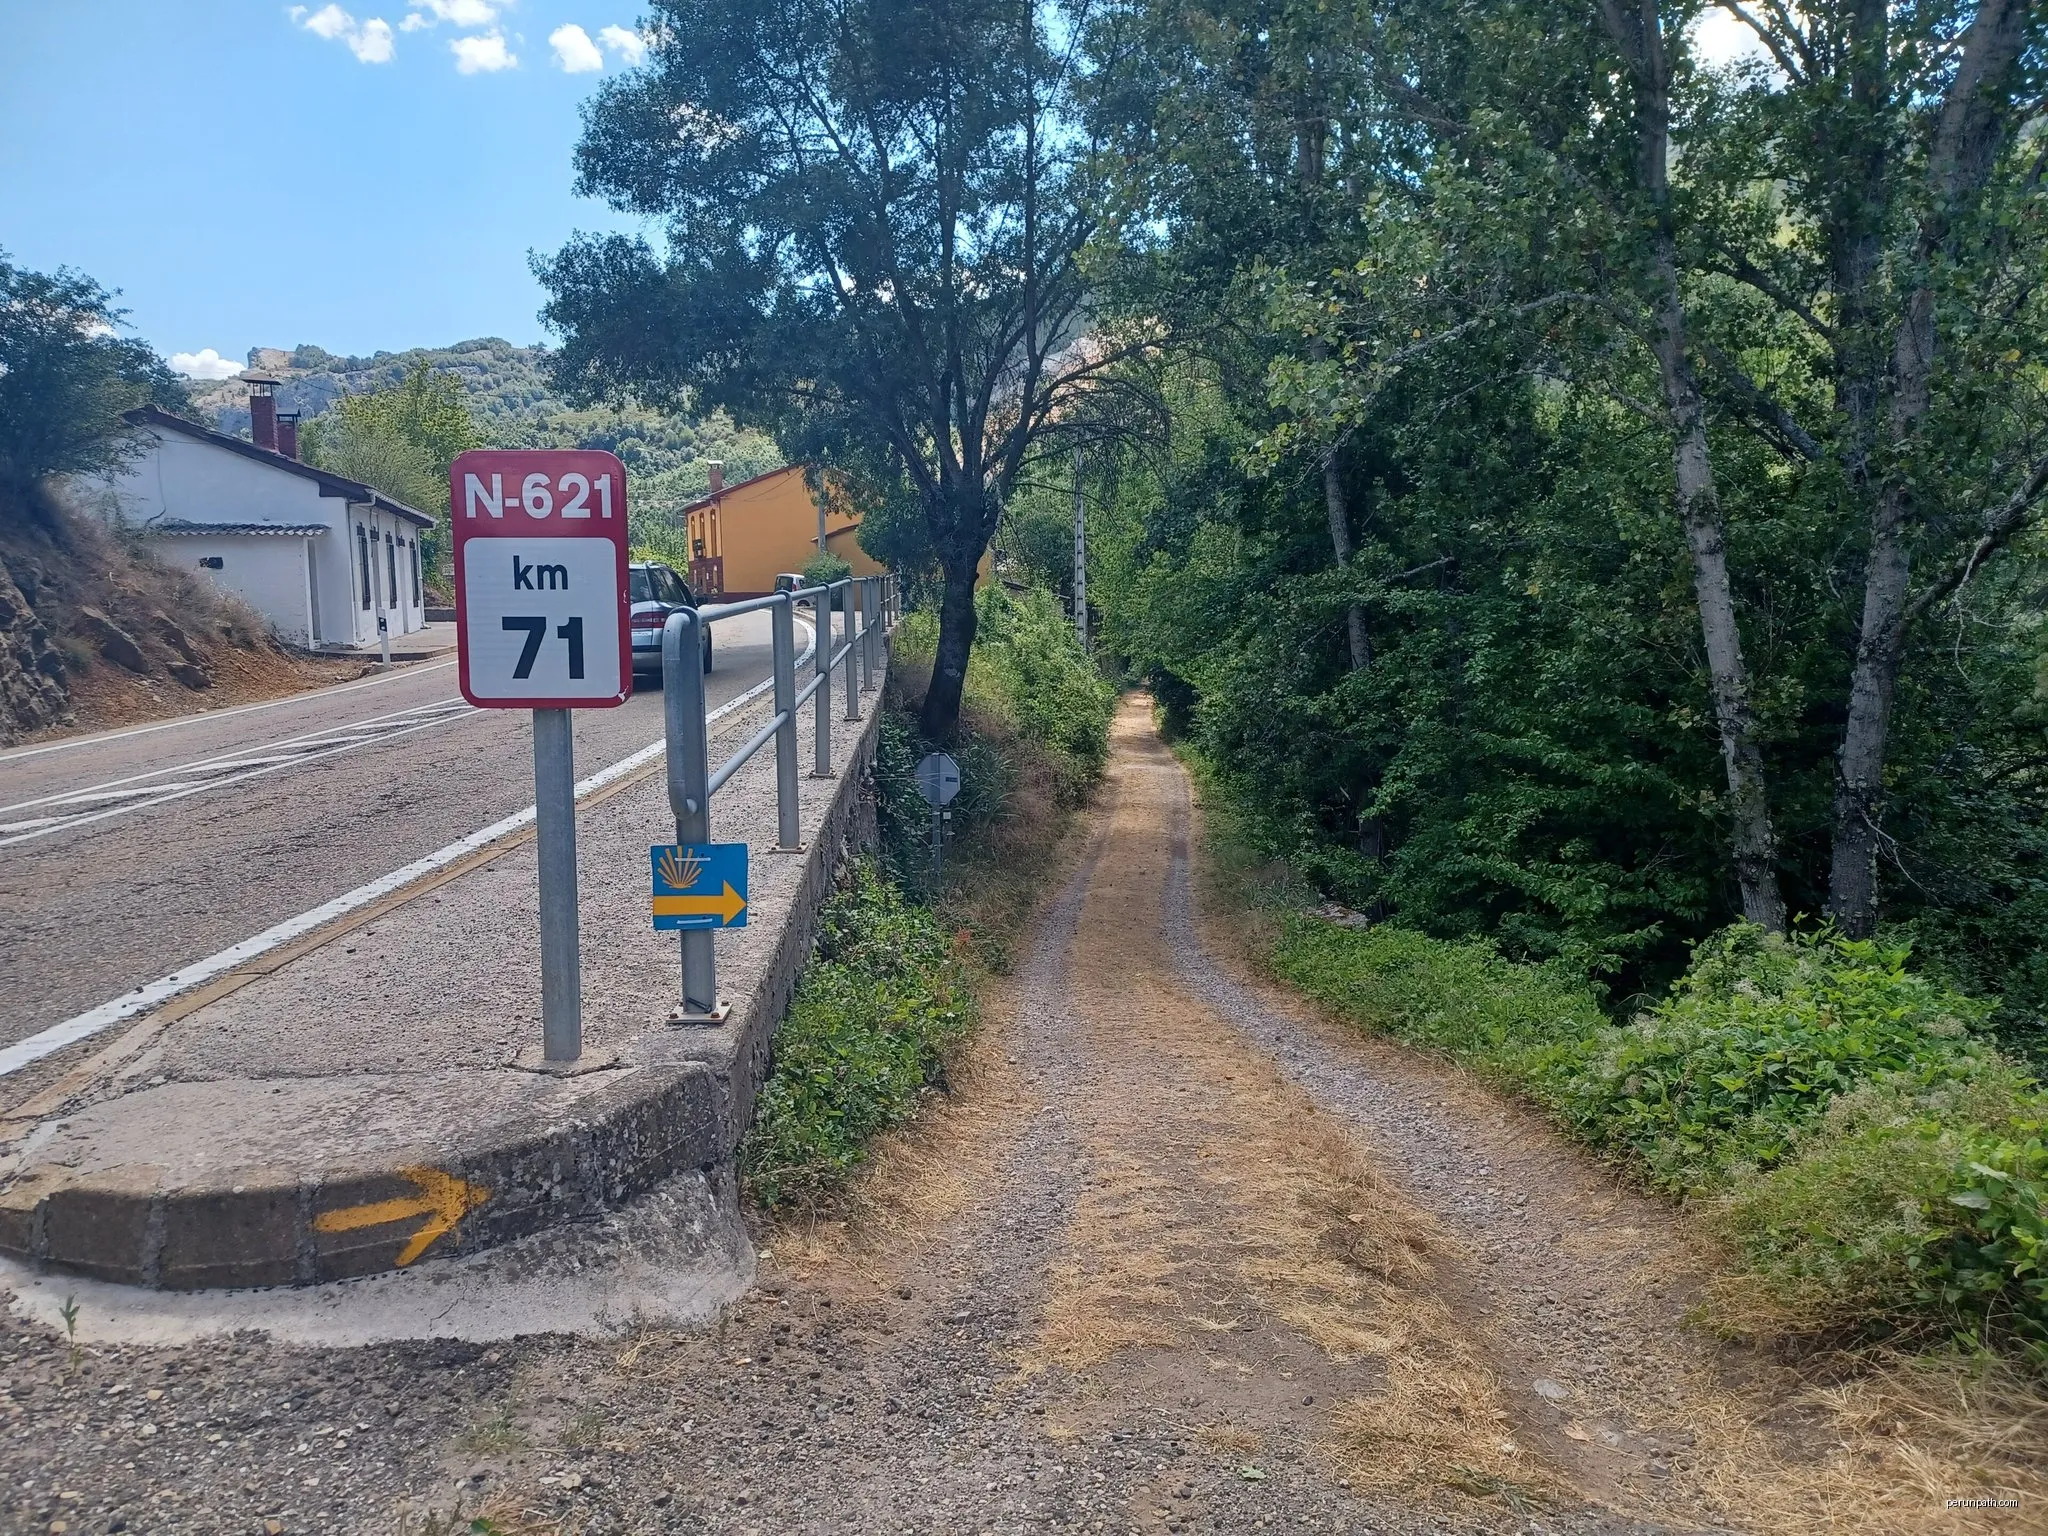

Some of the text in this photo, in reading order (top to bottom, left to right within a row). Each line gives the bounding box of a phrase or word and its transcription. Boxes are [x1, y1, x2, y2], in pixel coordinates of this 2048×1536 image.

[464, 472, 612, 519] N-621
[513, 555, 568, 590] km
[502, 616, 585, 679] 71
